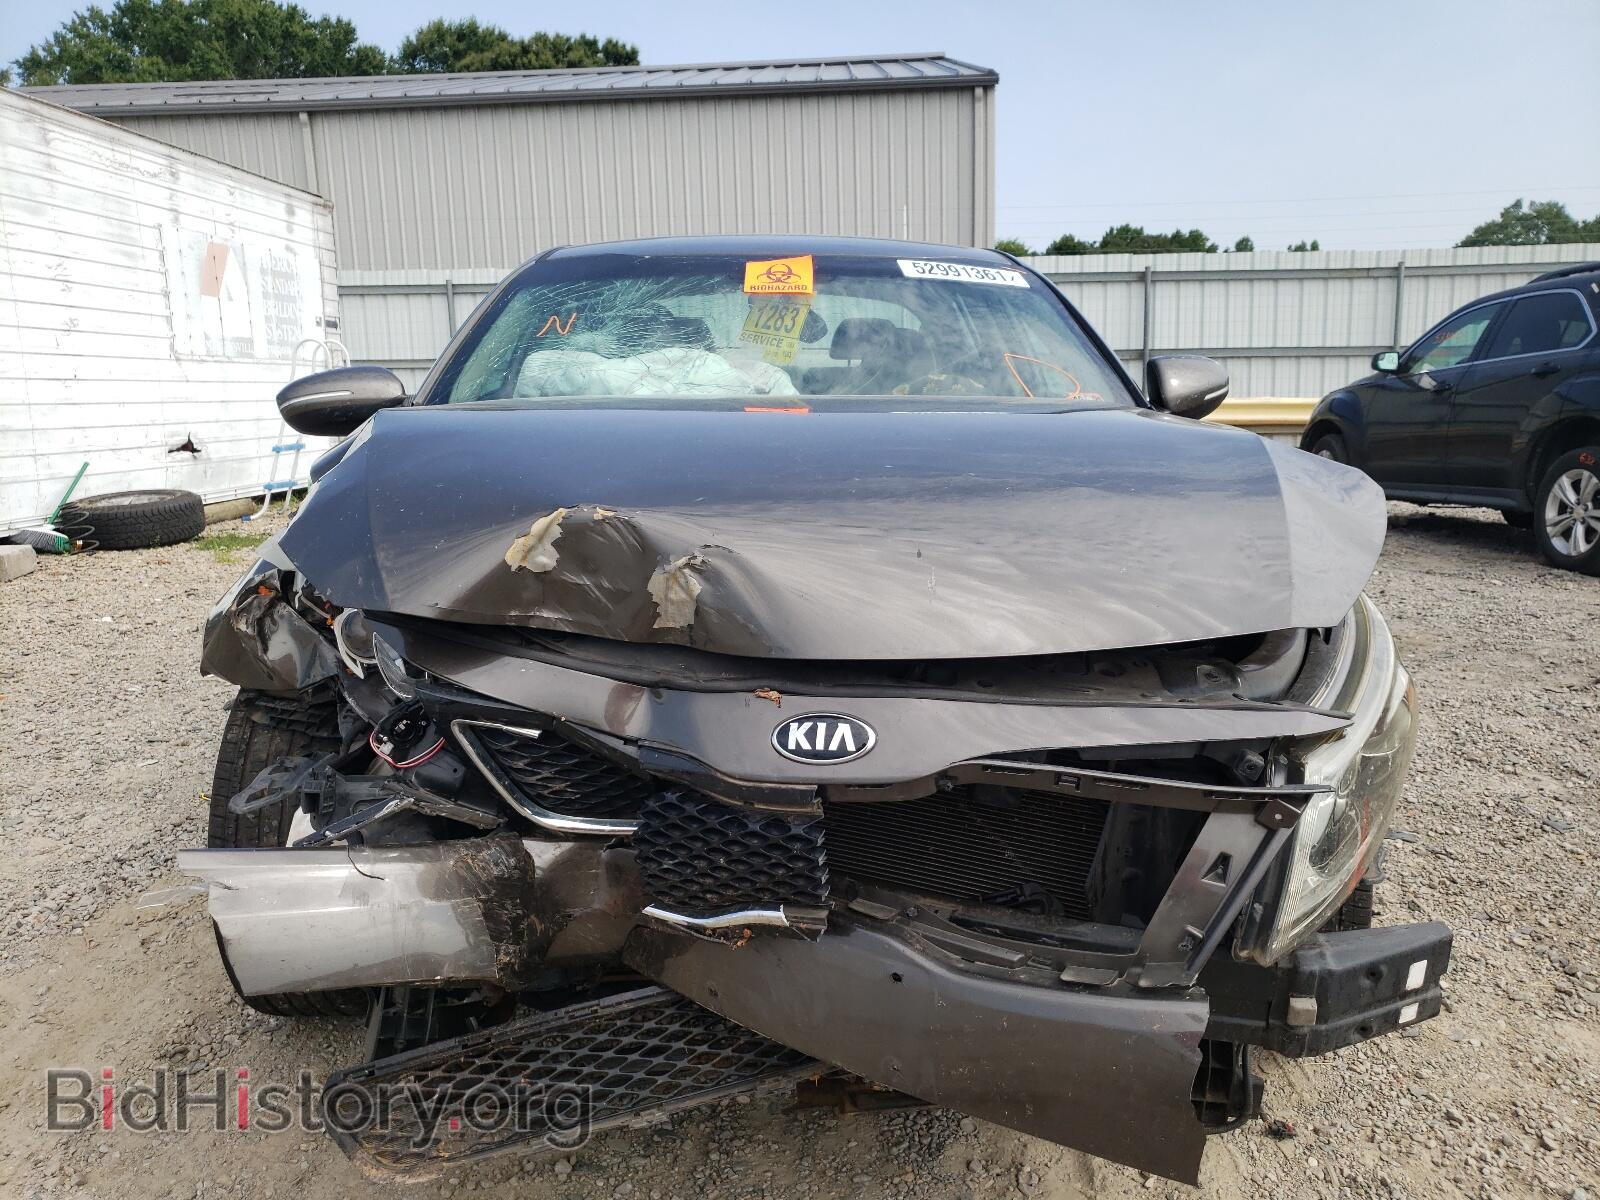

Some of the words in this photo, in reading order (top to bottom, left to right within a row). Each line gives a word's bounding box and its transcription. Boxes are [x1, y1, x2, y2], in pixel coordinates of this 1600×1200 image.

[754, 303, 801, 334] 1283
[739, 331, 783, 348] SERVICE
[787, 721, 857, 752] KIA
